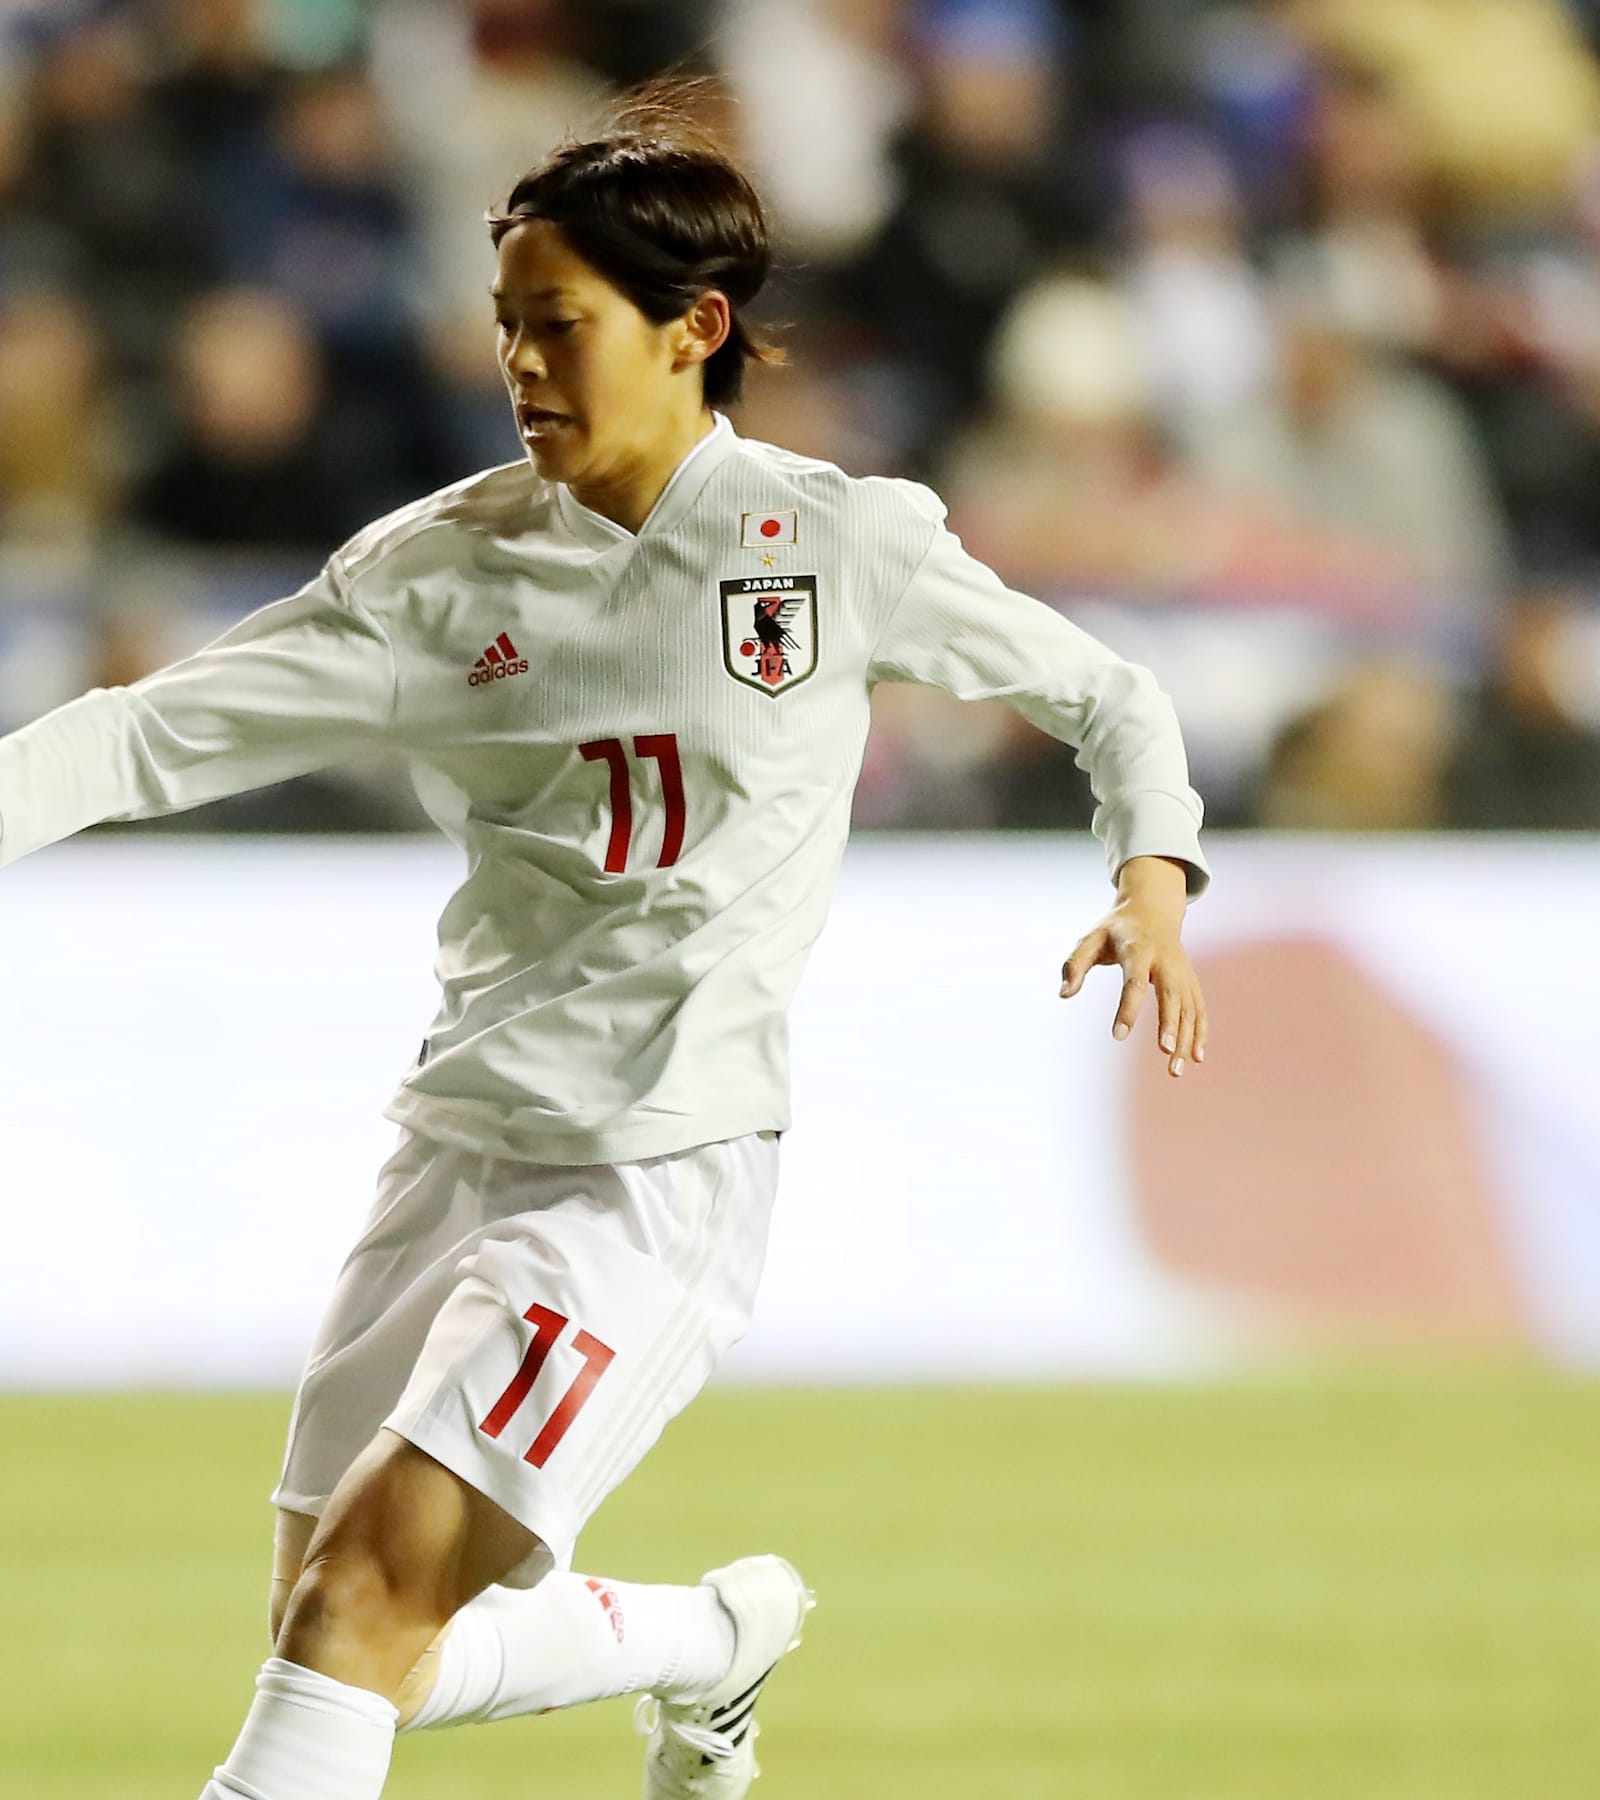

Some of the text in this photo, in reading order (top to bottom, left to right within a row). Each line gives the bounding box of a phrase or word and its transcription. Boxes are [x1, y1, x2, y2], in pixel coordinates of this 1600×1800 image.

[742, 577, 794, 591] JAPAN
[467, 659, 529, 687] adidas
[578, 733, 686, 873] 11
[478, 1302, 616, 1470] 11
